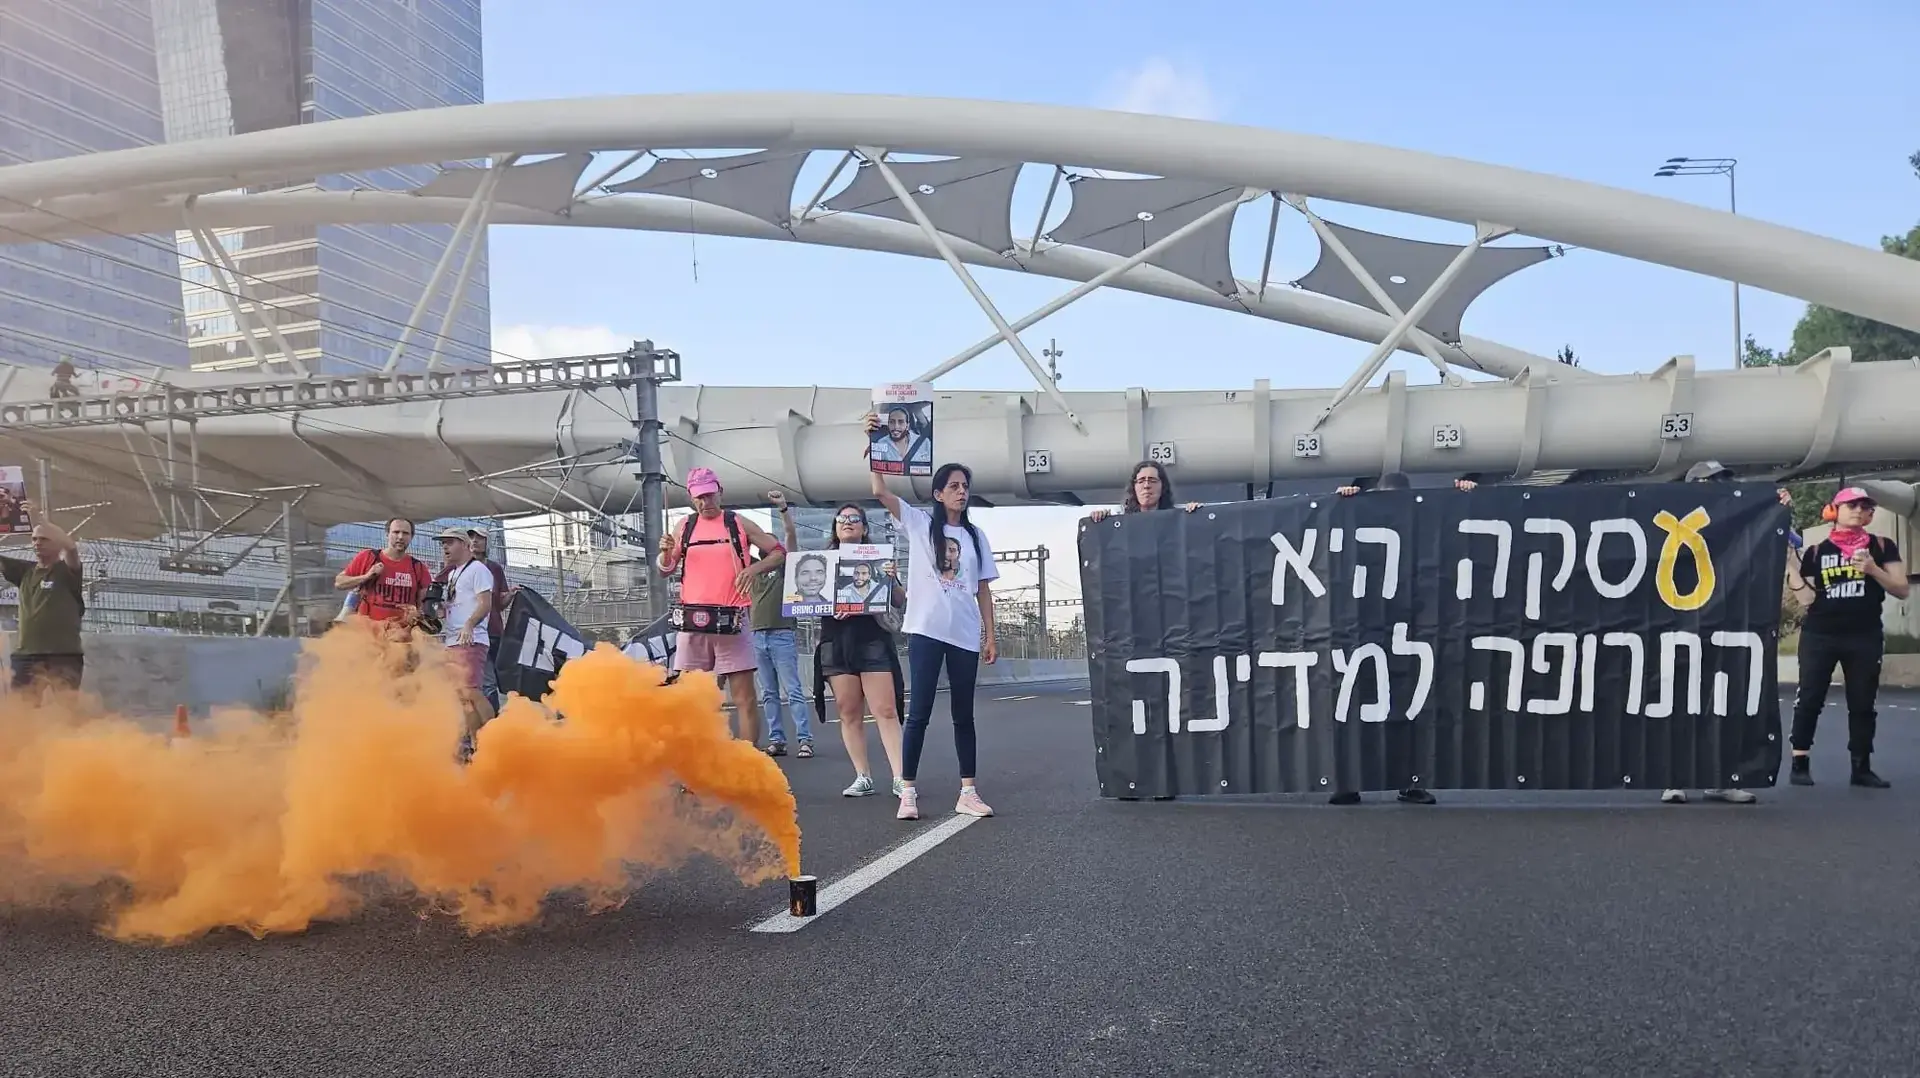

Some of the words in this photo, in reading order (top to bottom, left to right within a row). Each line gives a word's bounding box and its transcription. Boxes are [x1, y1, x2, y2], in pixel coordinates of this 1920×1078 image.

[1663, 418, 1689, 433] 5.3
[1435, 429, 1459, 442] 5.3
[1297, 438, 1318, 451] 5.3
[1151, 446, 1172, 459] 5.3
[1028, 455, 1047, 467] 5.3
[1271, 527, 1401, 606] היא
[1456, 506, 1717, 620] עסקה
[791, 605, 814, 615] BRING
[1125, 622, 1434, 735] למדינה
[1470, 630, 1764, 718] התרופה
